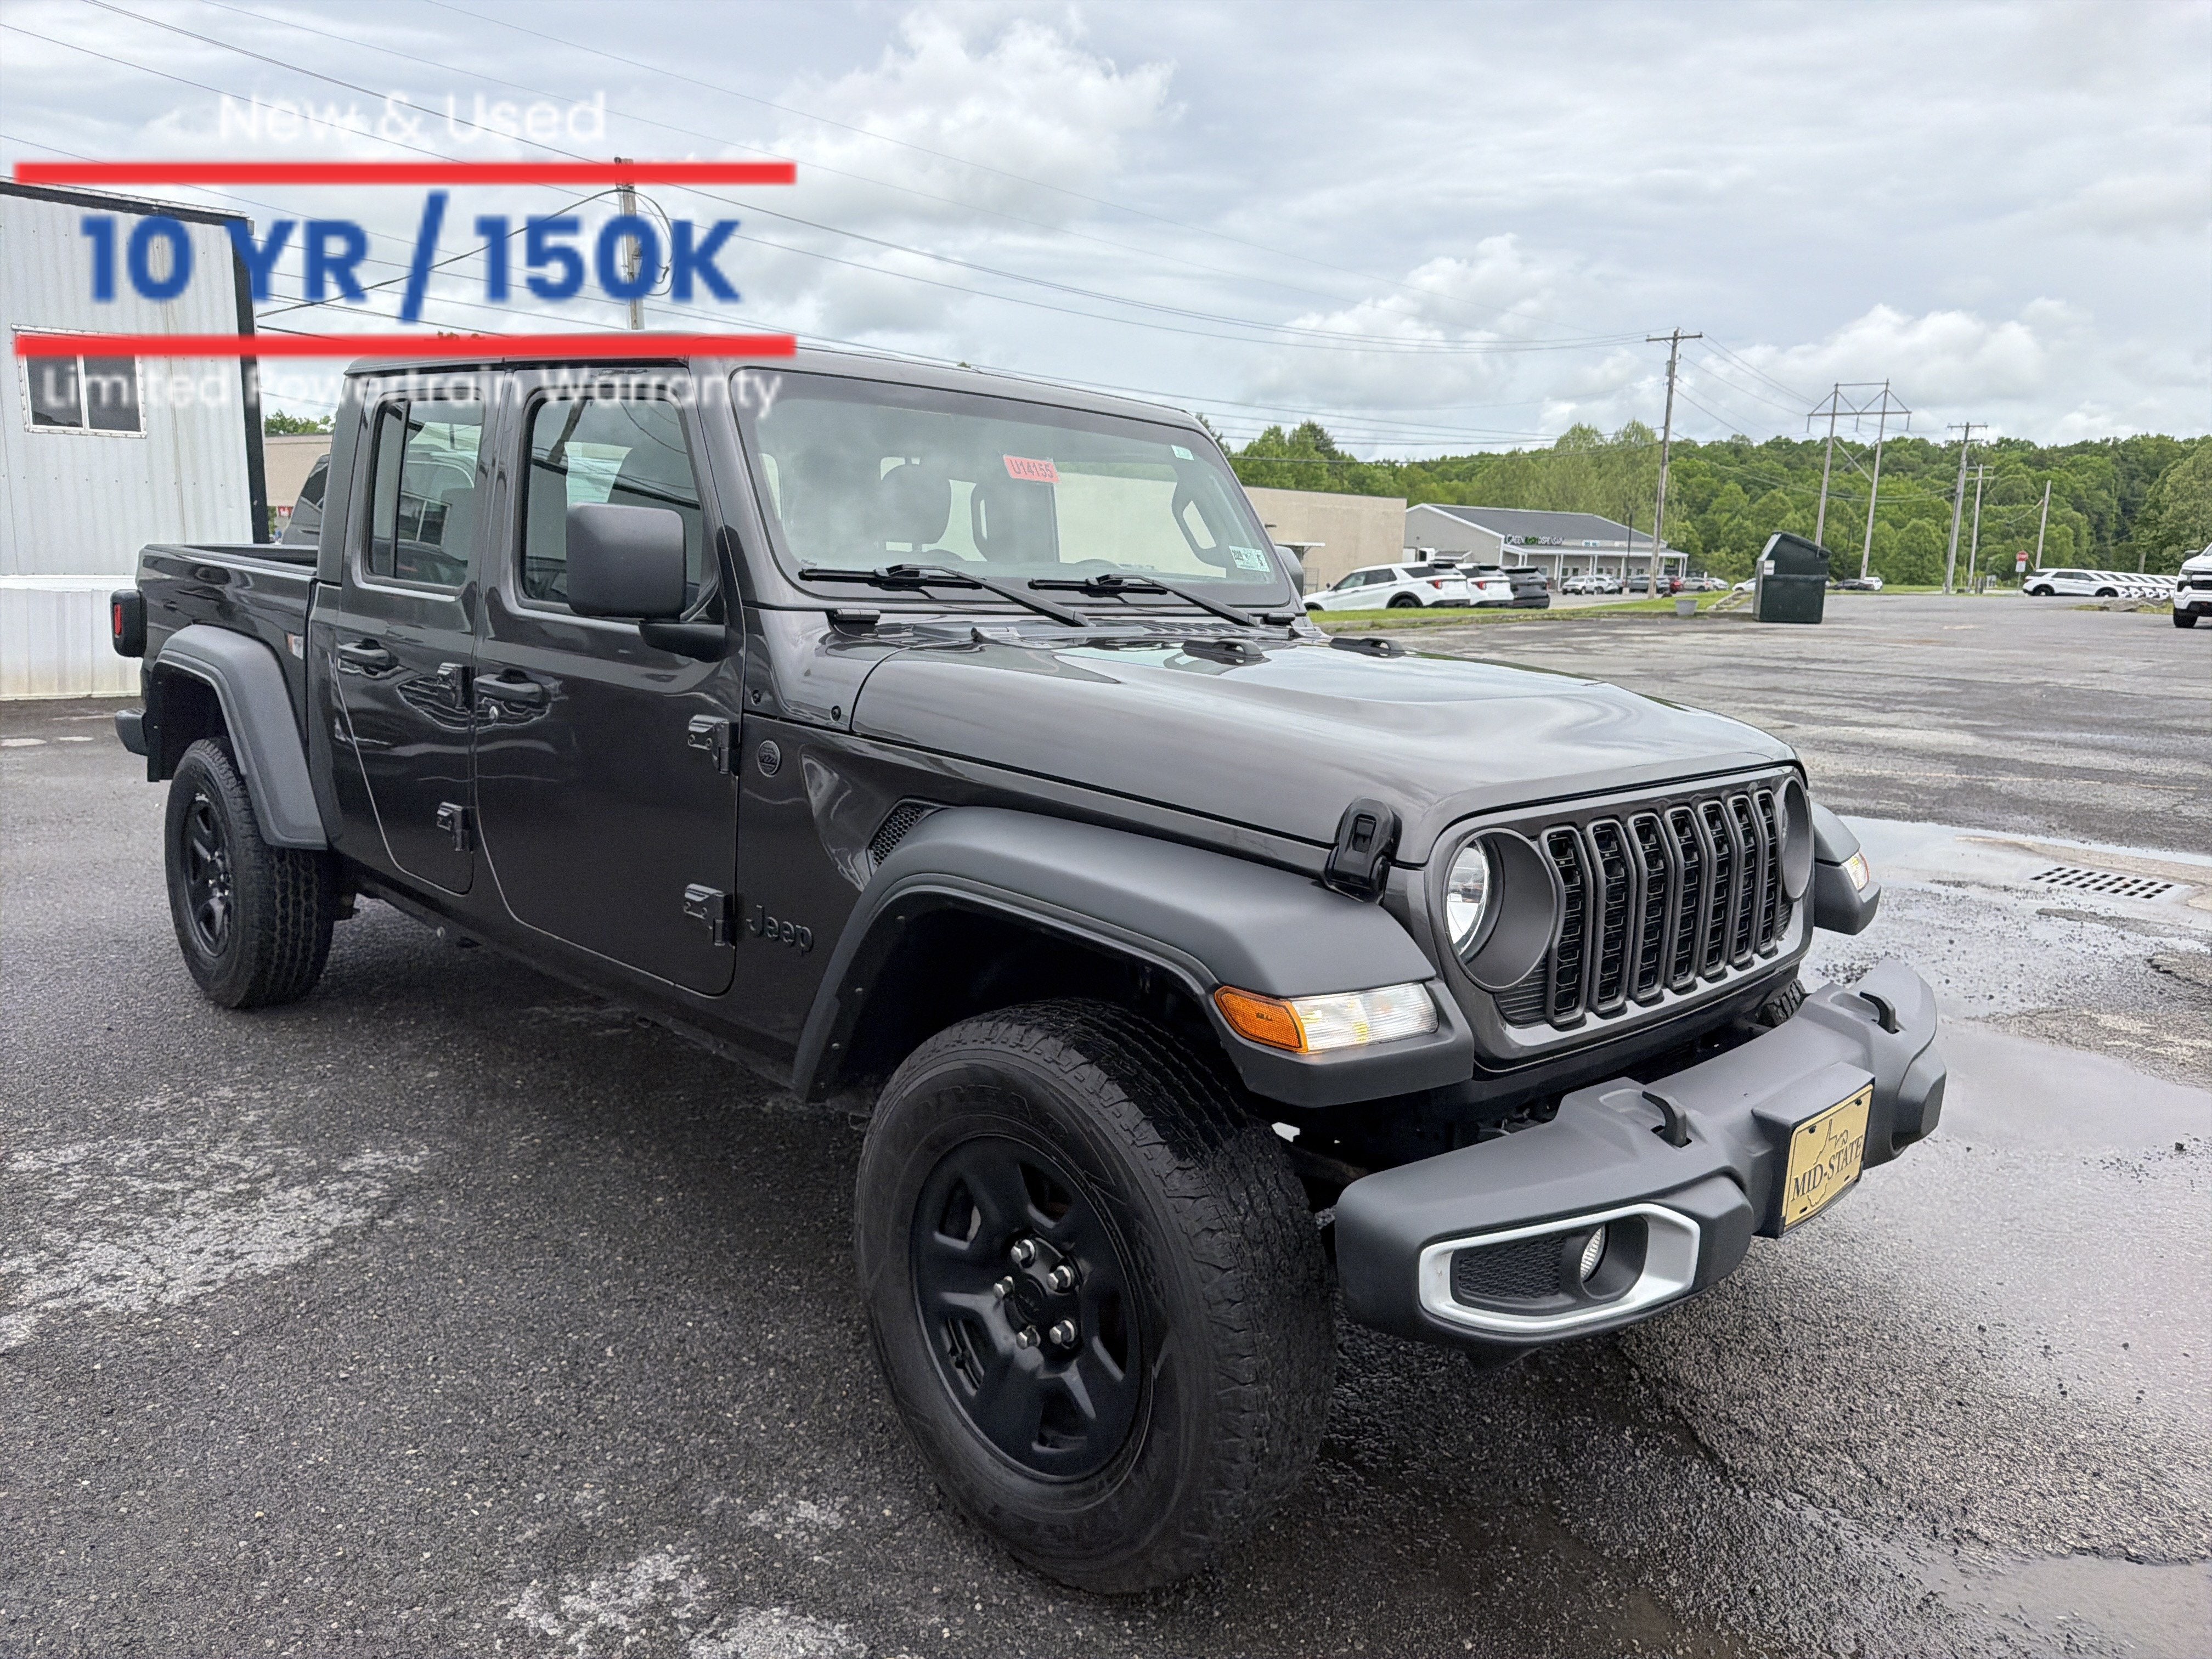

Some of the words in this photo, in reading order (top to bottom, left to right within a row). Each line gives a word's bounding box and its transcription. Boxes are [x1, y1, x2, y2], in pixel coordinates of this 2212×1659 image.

[1009, 460, 1053, 478] U14155
[746, 905, 812, 954] Jeep
[1791, 1134, 1864, 1202] MID-STATE
